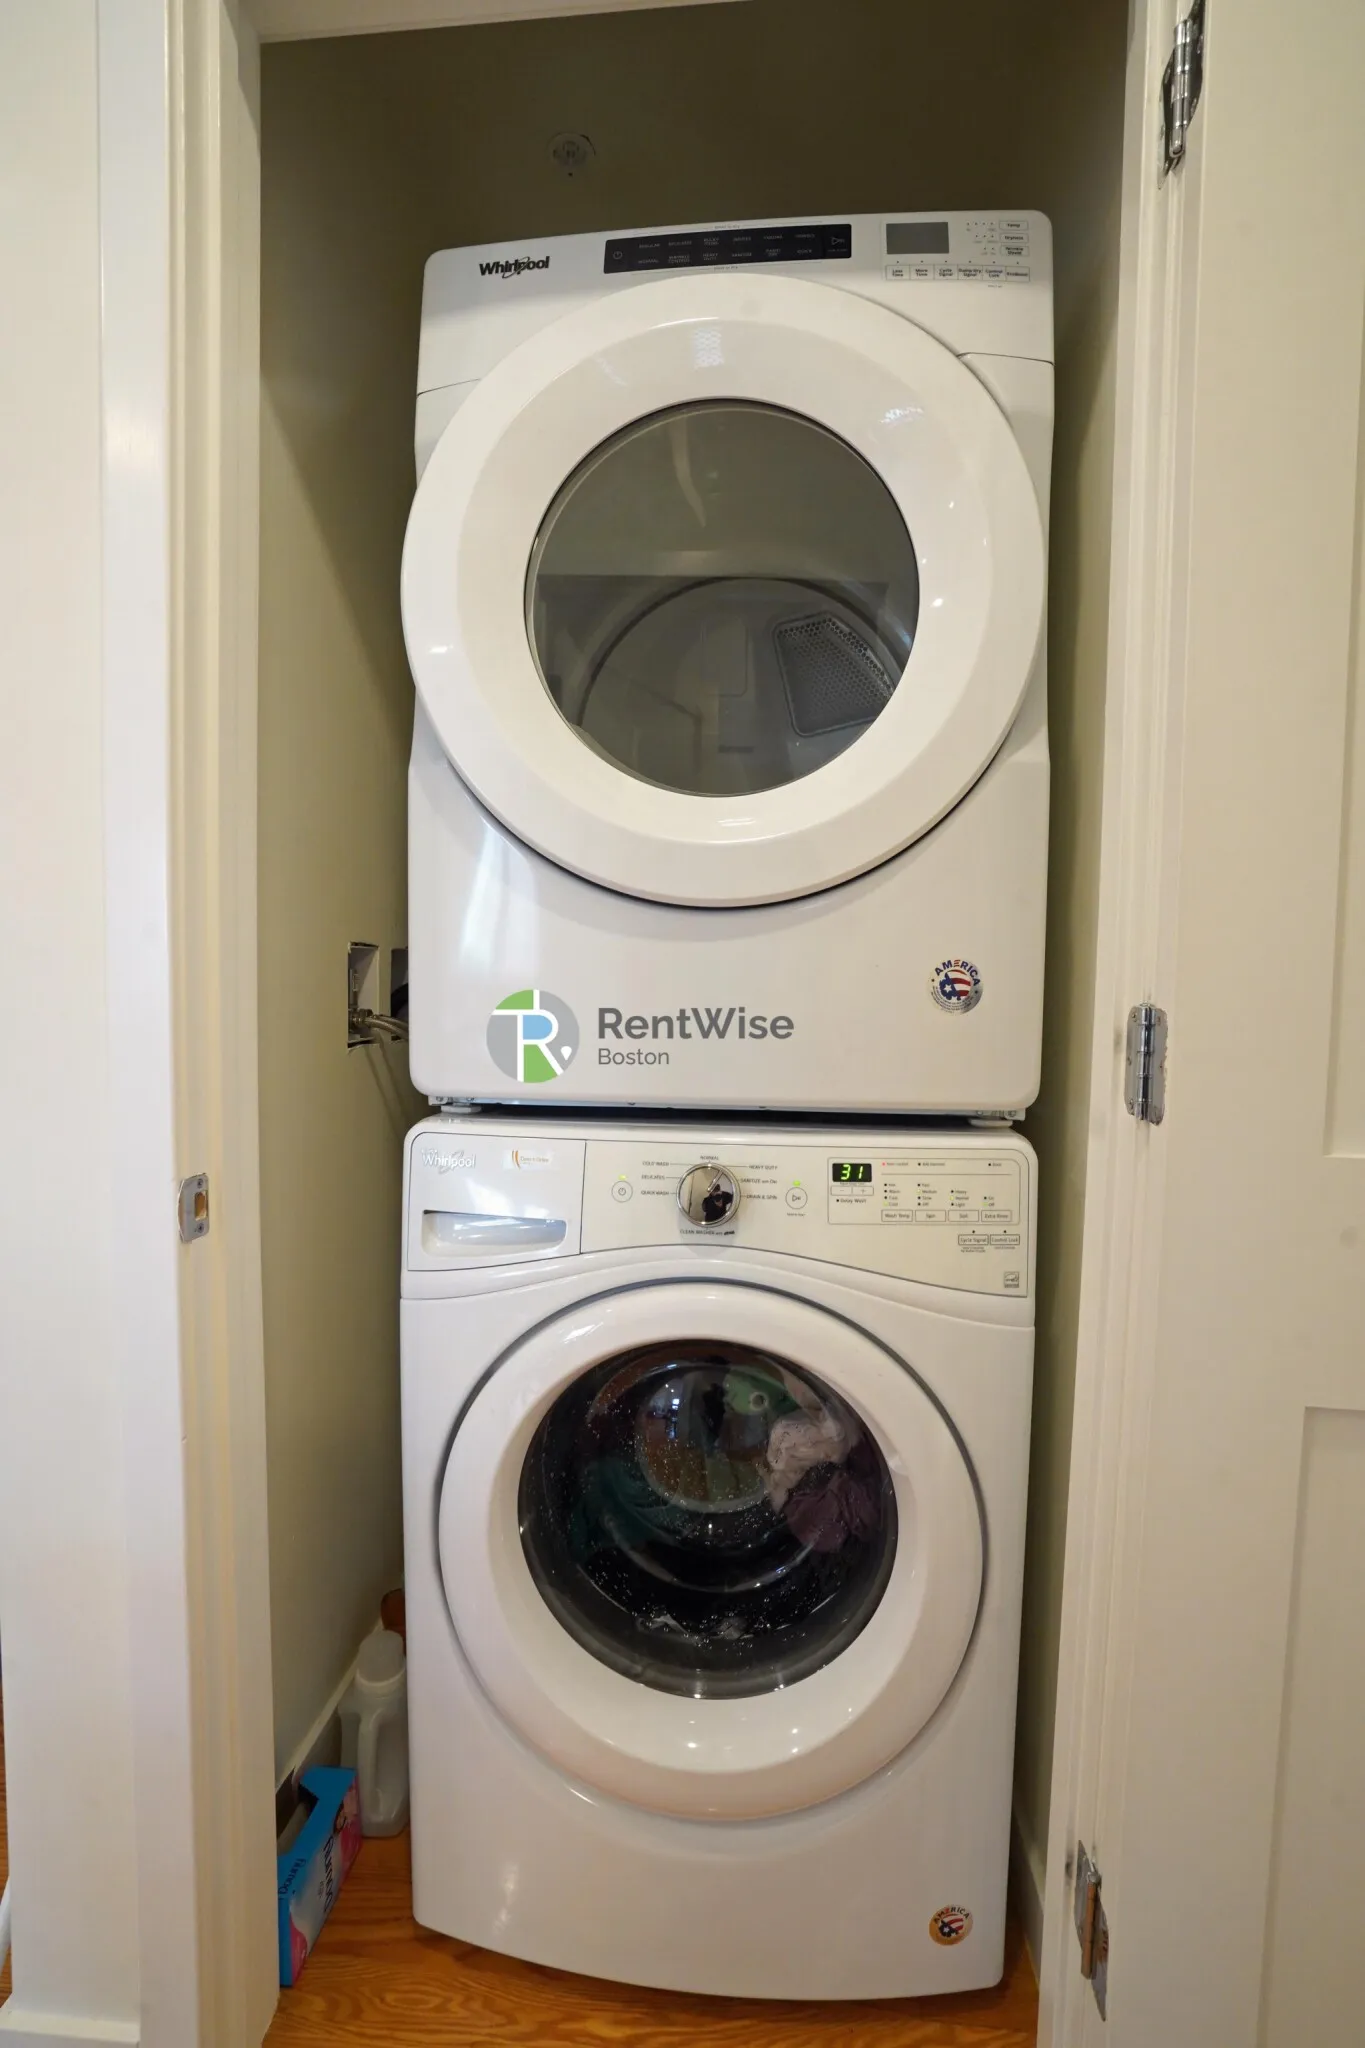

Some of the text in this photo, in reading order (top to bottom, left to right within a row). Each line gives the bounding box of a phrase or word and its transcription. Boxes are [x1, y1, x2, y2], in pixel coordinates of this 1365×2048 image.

[479, 256, 550, 279] Whirlpool
[934, 959, 980, 986] AMERICA
[422, 1149, 476, 1173] Whirlpool
[840, 1164, 864, 1180] 31
[278, 1858, 306, 1895] Downy
